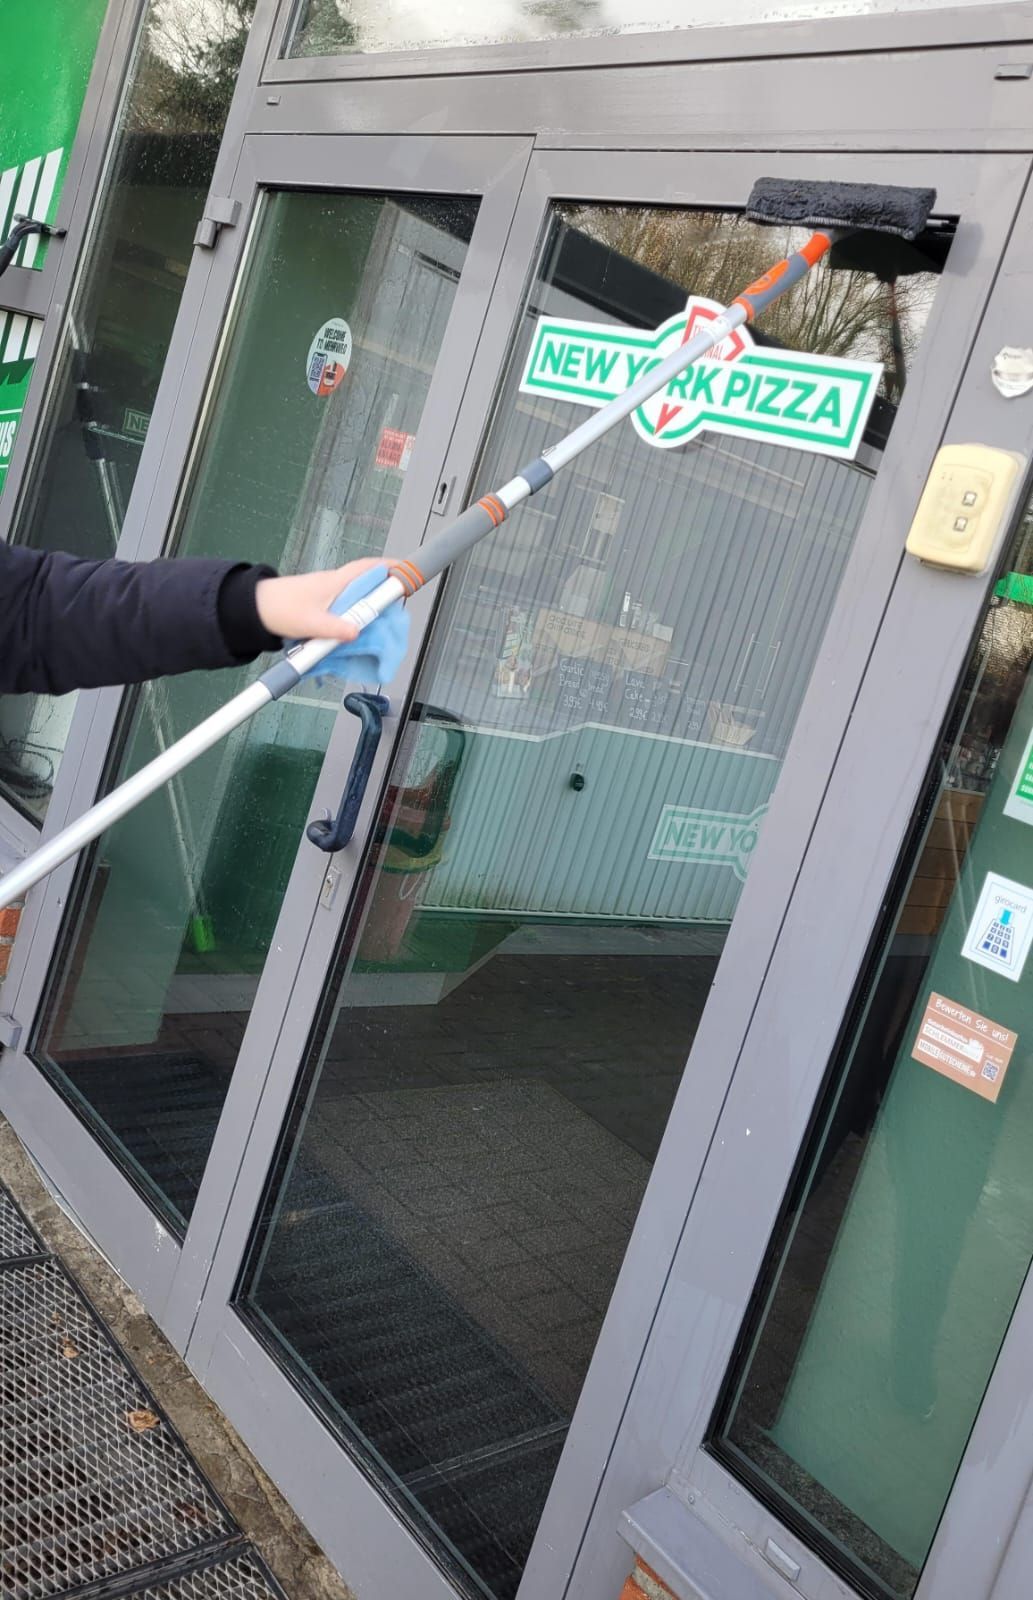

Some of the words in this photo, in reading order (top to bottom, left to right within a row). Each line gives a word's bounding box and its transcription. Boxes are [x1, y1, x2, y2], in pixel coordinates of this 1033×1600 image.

[539, 341, 619, 384] NEW
[724, 369, 842, 427] PIZZA
[664, 820, 727, 850] NEW
[995, 895, 1027, 913] girocard
[935, 998, 972, 1025] Bewerten
[975, 1019, 989, 1033] Sie
